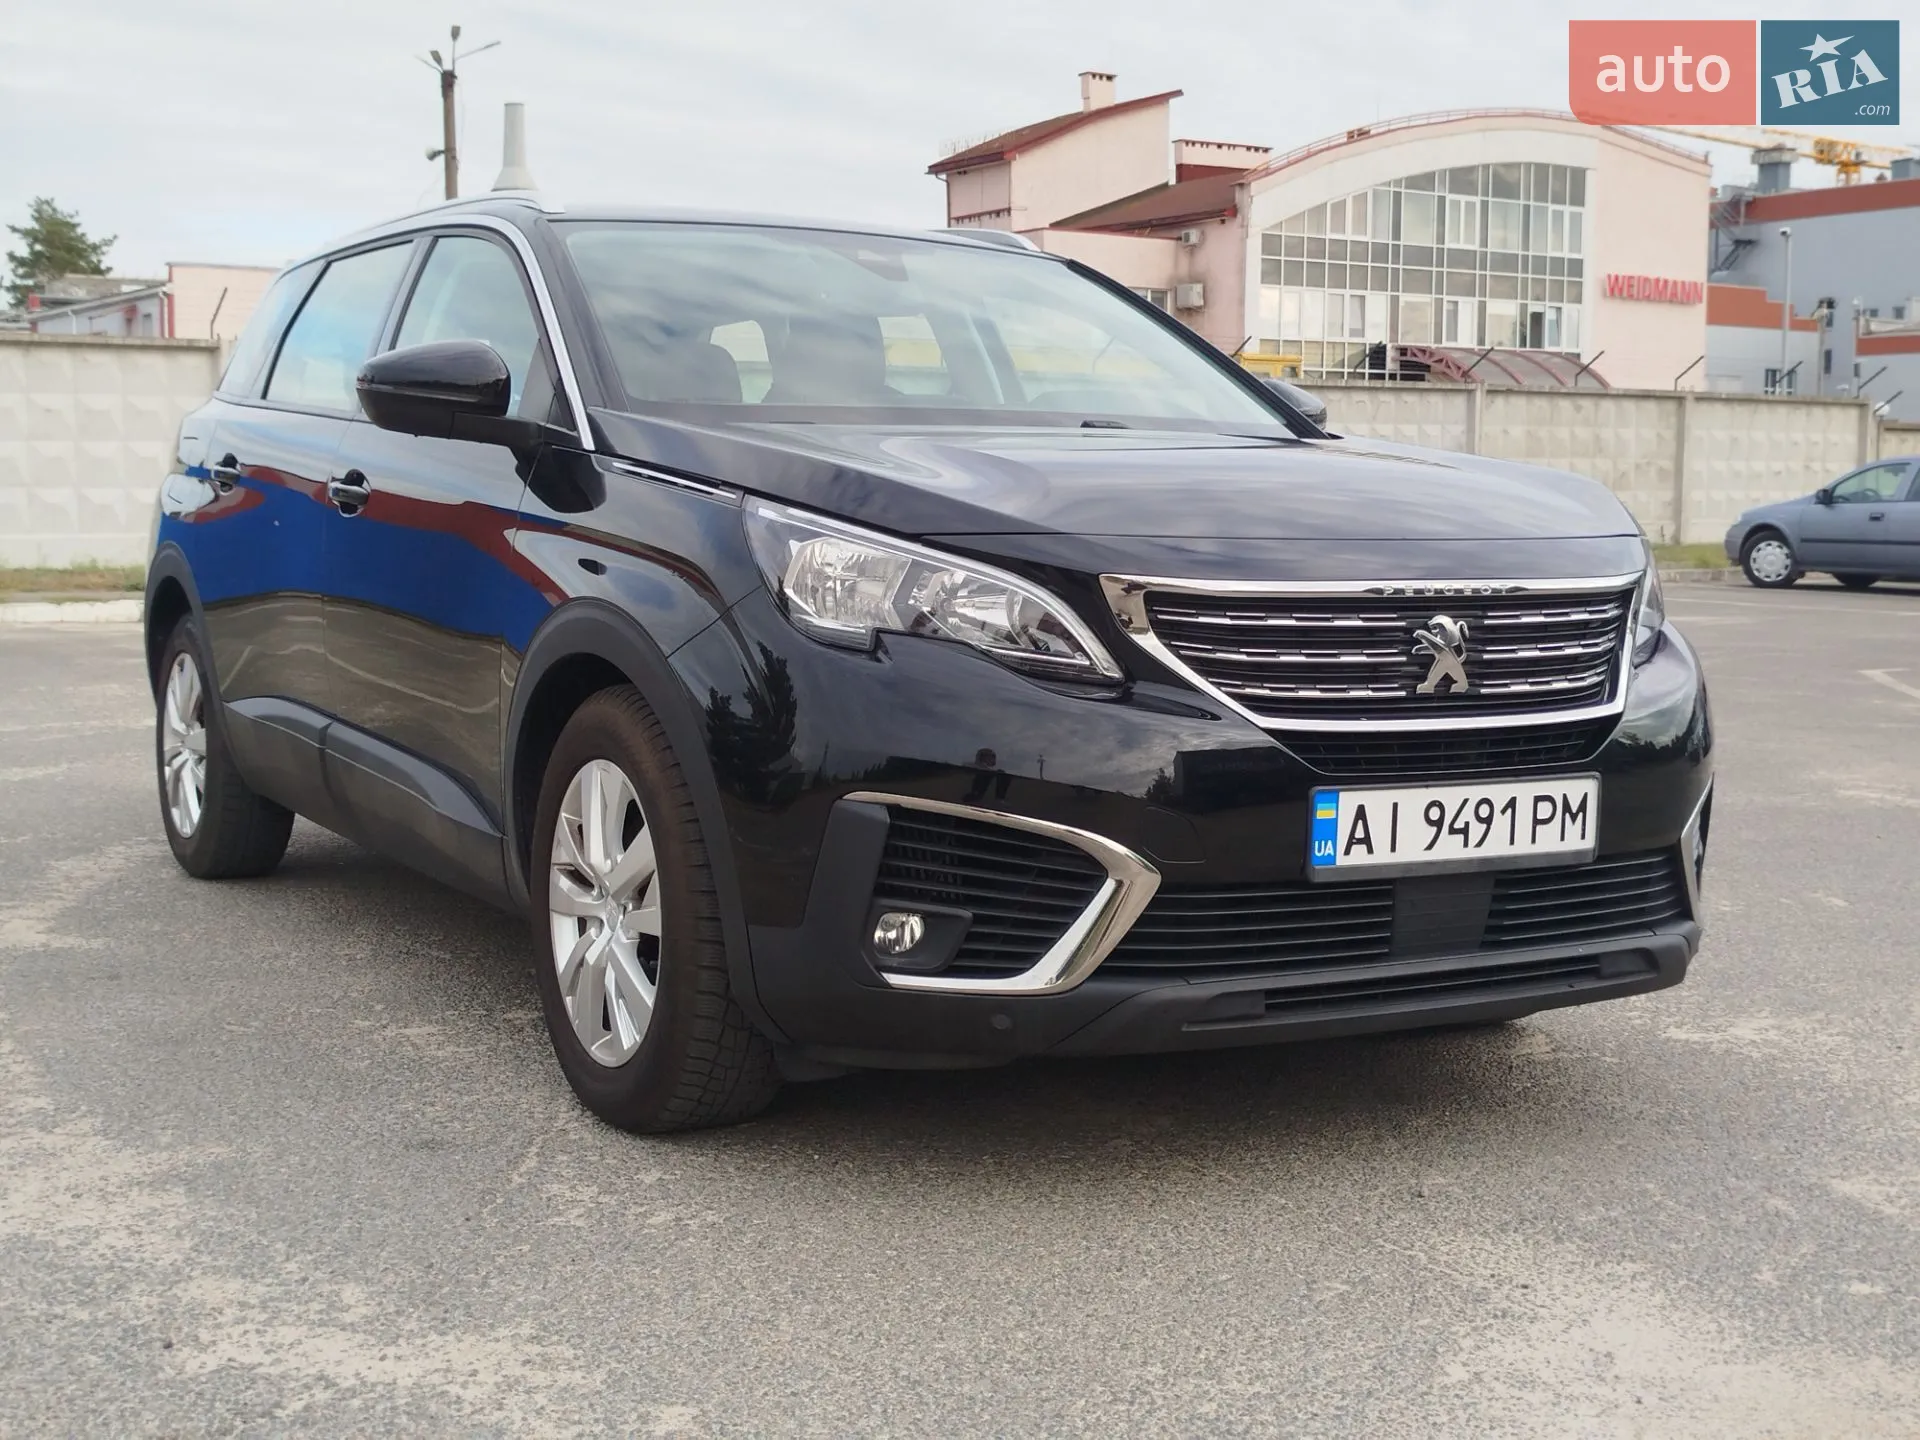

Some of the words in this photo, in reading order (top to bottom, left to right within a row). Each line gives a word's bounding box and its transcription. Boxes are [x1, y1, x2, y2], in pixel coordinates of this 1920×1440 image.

[1605, 272, 1704, 305] WEIDMANN
[1383, 584, 1508, 597] PEUGEOT
[1343, 801, 1399, 857] AI
[1423, 797, 1518, 852] 9491
[1530, 791, 1589, 845] PM
[1314, 839, 1334, 857] UA
